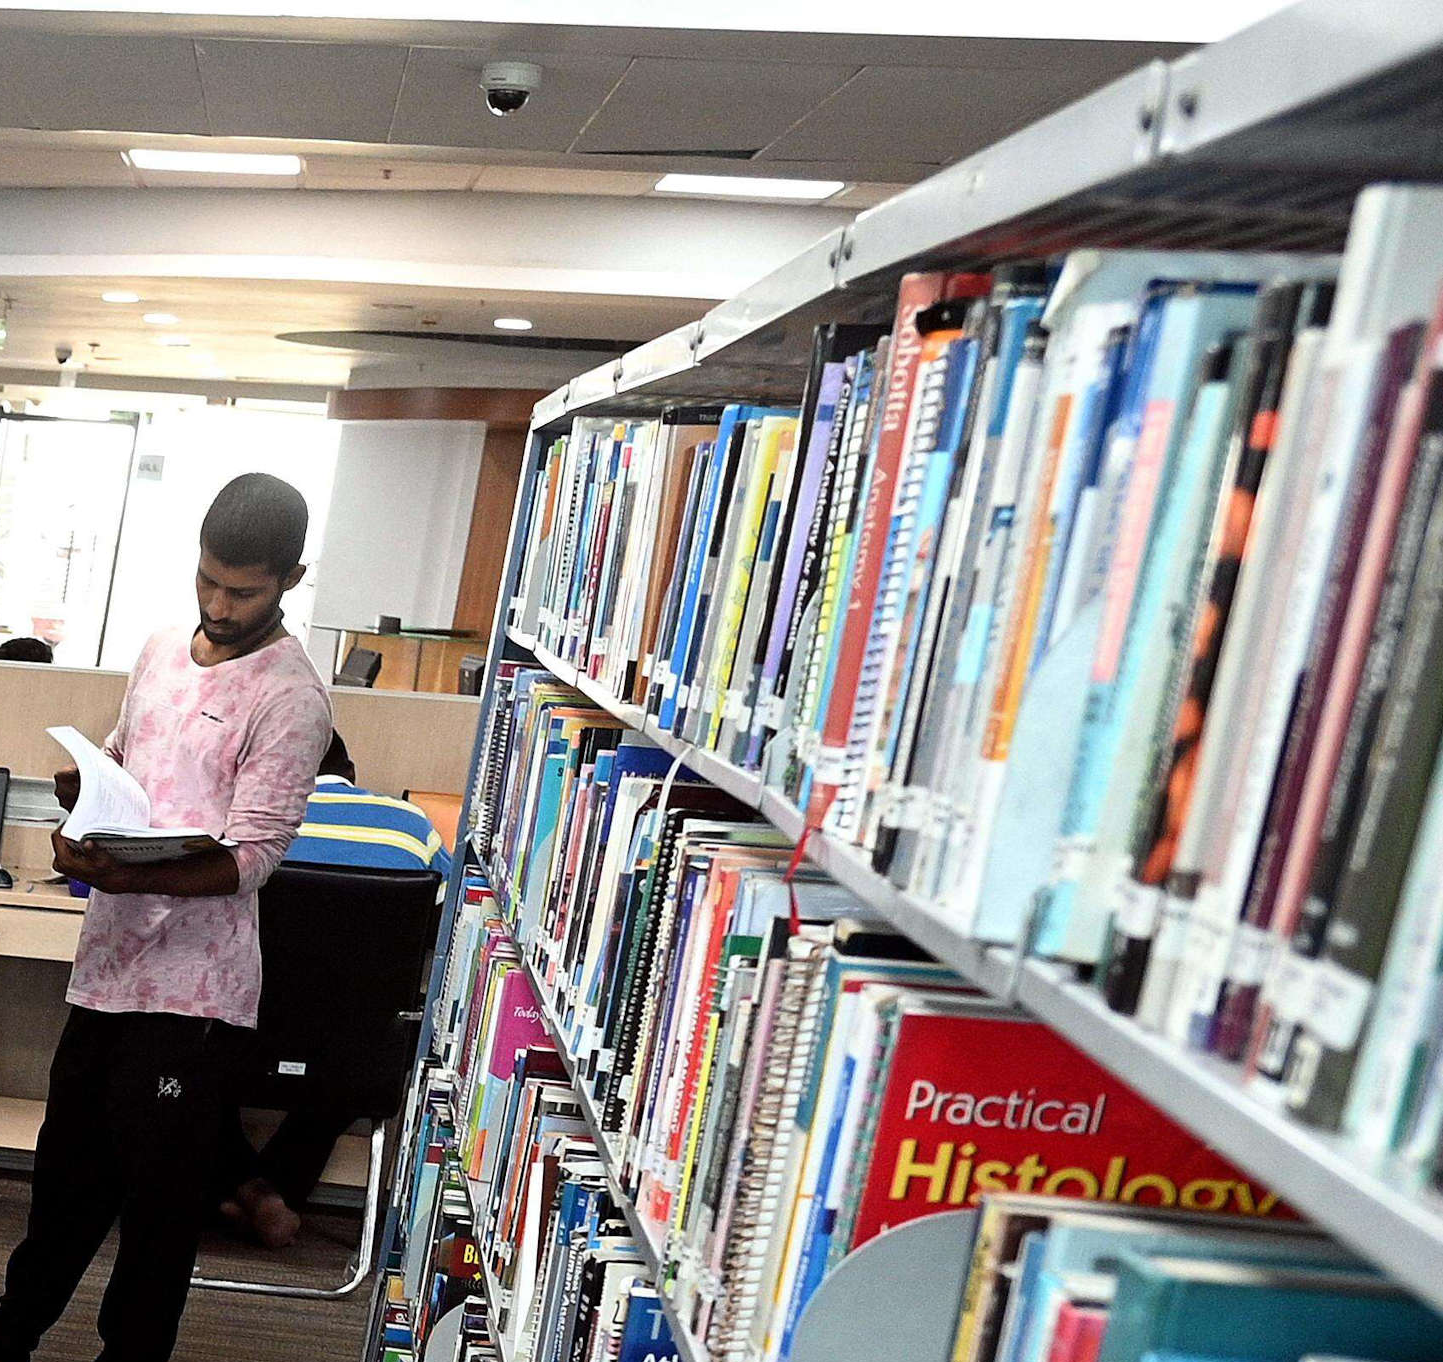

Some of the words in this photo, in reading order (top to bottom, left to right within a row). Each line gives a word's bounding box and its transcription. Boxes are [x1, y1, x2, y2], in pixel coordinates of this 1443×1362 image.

[882, 303, 925, 432] Sobotta
[828, 383, 852, 457] Clinical
[807, 460, 837, 548] Anatomy
[849, 466, 888, 590] Anatomy
[801, 551, 818, 576] for
[786, 579, 812, 651] Students
[686, 996, 702, 1052] HUMAN
[670, 1055, 689, 1134] ANATOMY
[905, 1079, 1107, 1136] Practical
[889, 1137, 1286, 1217] Histology
[565, 1240, 581, 1291] Human
[556, 1294, 572, 1362] Anatomy
